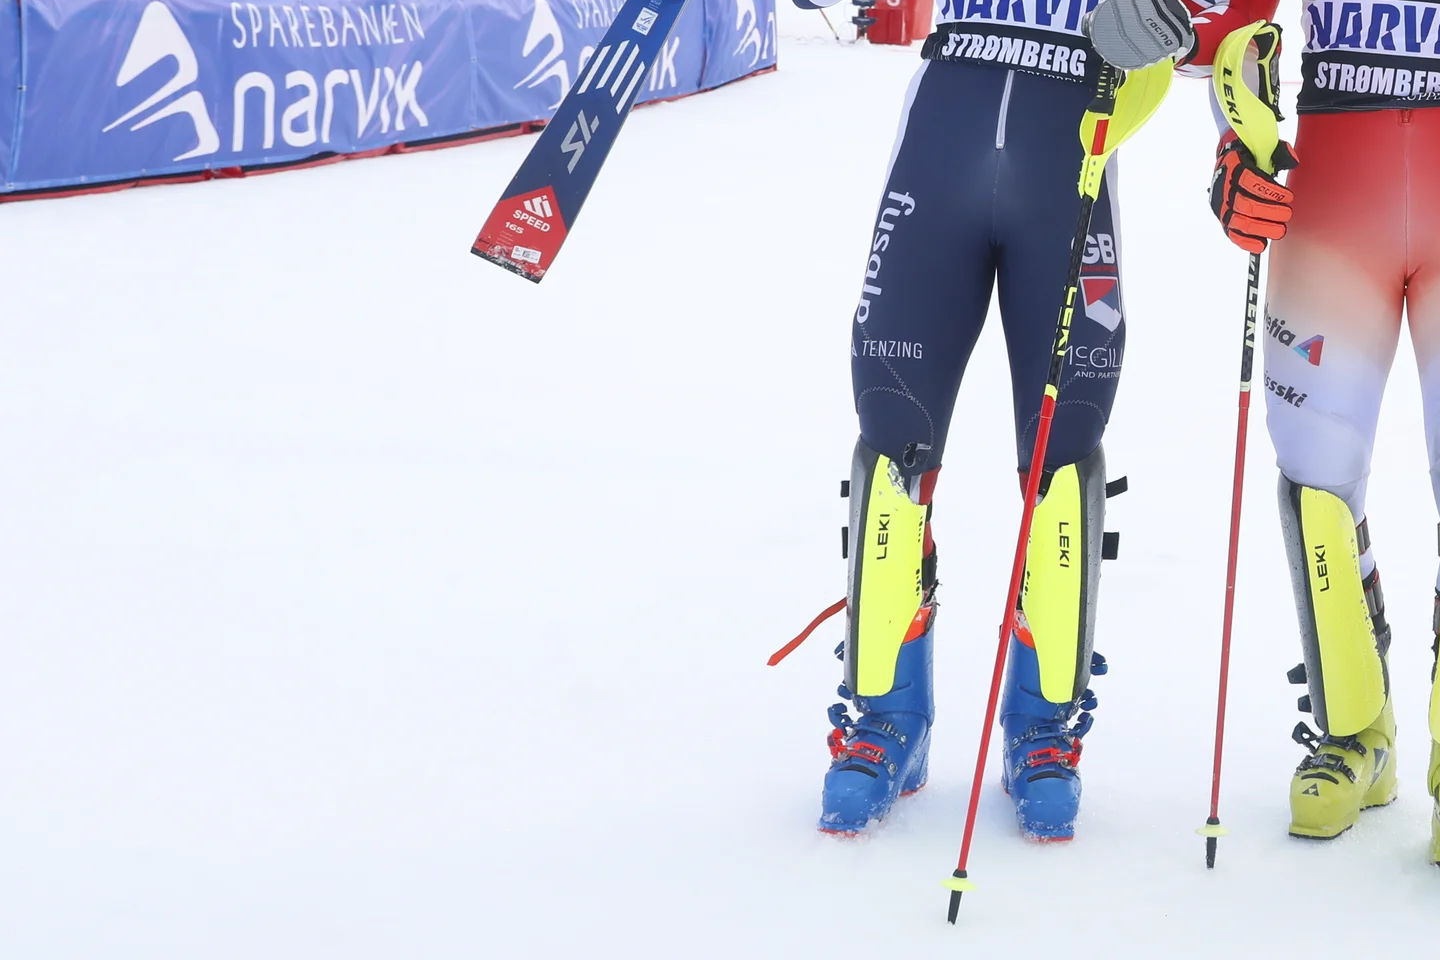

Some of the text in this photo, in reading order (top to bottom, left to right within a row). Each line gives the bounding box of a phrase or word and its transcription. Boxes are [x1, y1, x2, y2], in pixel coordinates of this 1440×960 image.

[230, 1, 427, 50] SPAREBANKEN
[1146, 17, 1173, 47] racing
[942, 33, 1088, 77] STRØMBERG
[231, 59, 429, 153] narvik
[1221, 67, 1243, 126] LEKI
[1252, 181, 1285, 201] racing
[505, 222, 525, 234] 165
[513, 210, 551, 232] SPEED
[856, 190, 916, 325] fusalp
[1057, 286, 1078, 357] LEKI
[1245, 285, 1258, 349] LEKI
[862, 340, 923, 359] TENZING
[876, 513, 890, 560] LEKI
[1058, 521, 1070, 568] LEKI
[1314, 545, 1330, 592] LEKI
